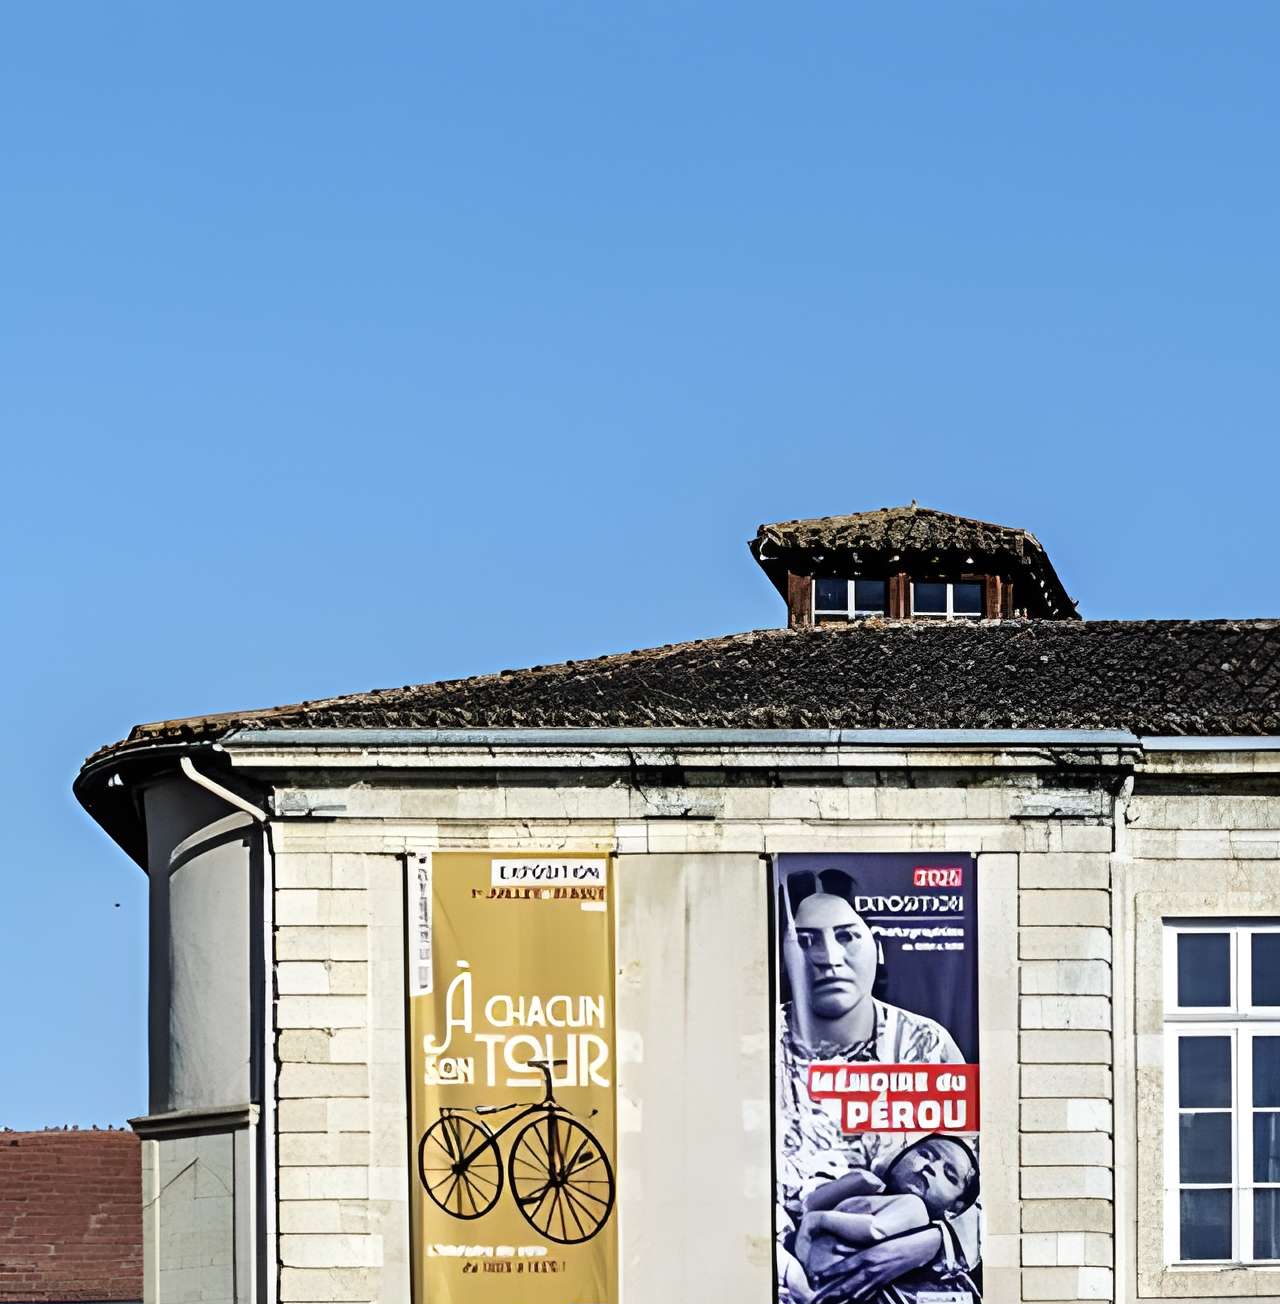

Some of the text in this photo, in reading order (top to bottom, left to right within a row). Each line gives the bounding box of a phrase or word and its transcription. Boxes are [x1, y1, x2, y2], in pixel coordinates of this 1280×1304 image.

[485, 994, 605, 1028] CHACUN
[424, 1033, 610, 1087] SON TOUR
[847, 1091, 967, 1129] PÉROU
